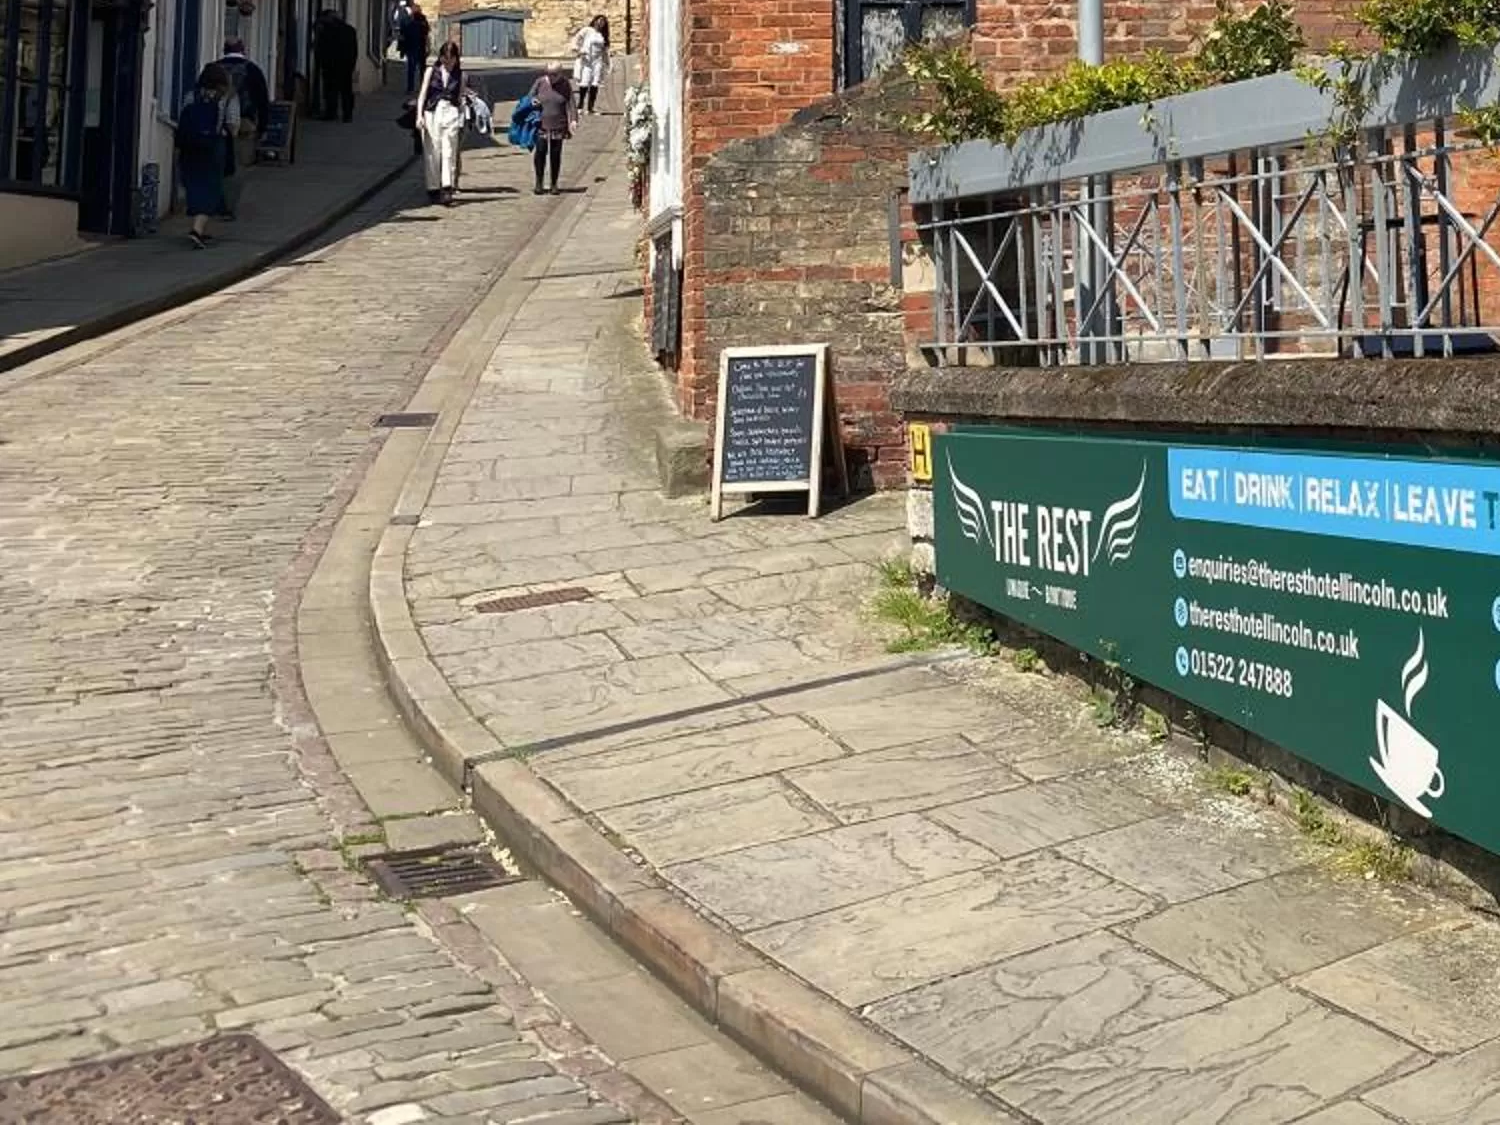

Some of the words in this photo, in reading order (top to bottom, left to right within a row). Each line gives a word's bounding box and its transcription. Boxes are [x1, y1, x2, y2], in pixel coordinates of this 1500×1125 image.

[911, 430, 929, 475] H
[1180, 468, 1219, 502] EAT
[1234, 472, 1295, 510] DRINK
[1306, 477, 1380, 518] RELAX
[1393, 482, 1477, 529] LEAVE
[991, 500, 1031, 567] THE
[1036, 505, 1092, 576] REST
[1188, 555, 1449, 619] enquiries@theresthotellincoln.co.uk
[1189, 601, 1360, 659] theresthotellincoln.co.uk
[1190, 648, 1234, 683] 01522
[1239, 658, 1293, 698] 247888
